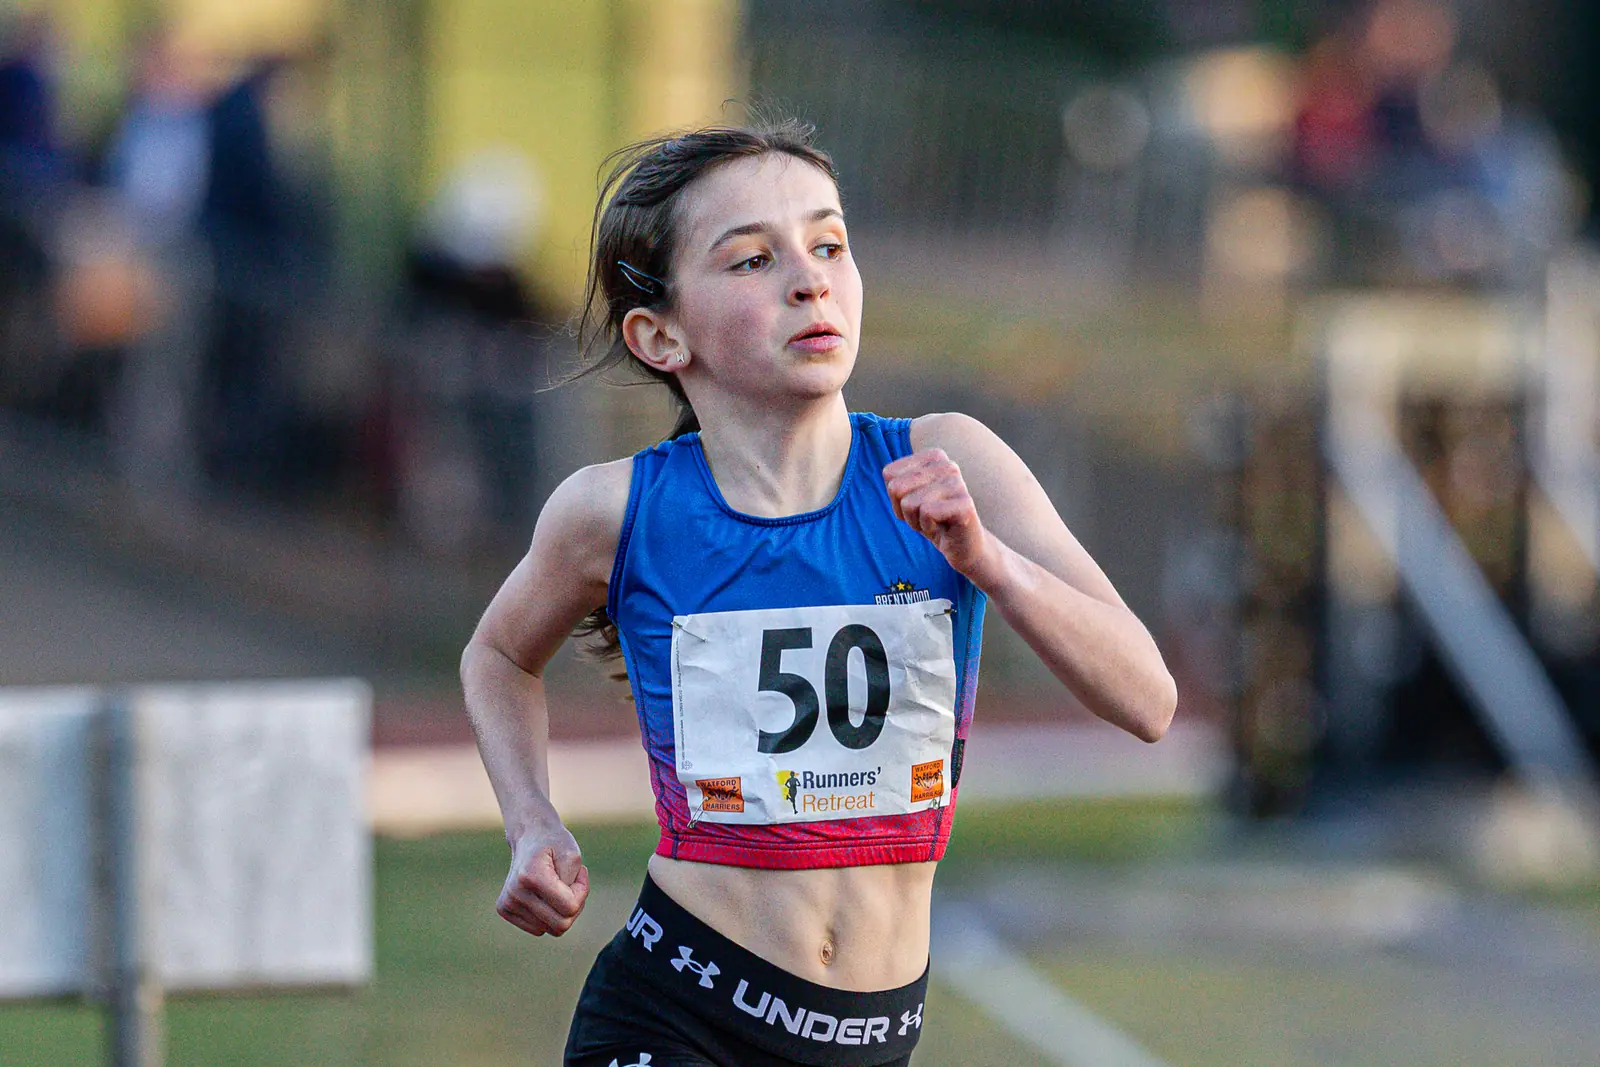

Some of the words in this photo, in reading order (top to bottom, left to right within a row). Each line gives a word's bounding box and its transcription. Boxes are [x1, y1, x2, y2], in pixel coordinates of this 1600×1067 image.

[757, 623, 890, 754] 50
[802, 791, 876, 812] Retreat
[732, 978, 890, 1045] UNDER
